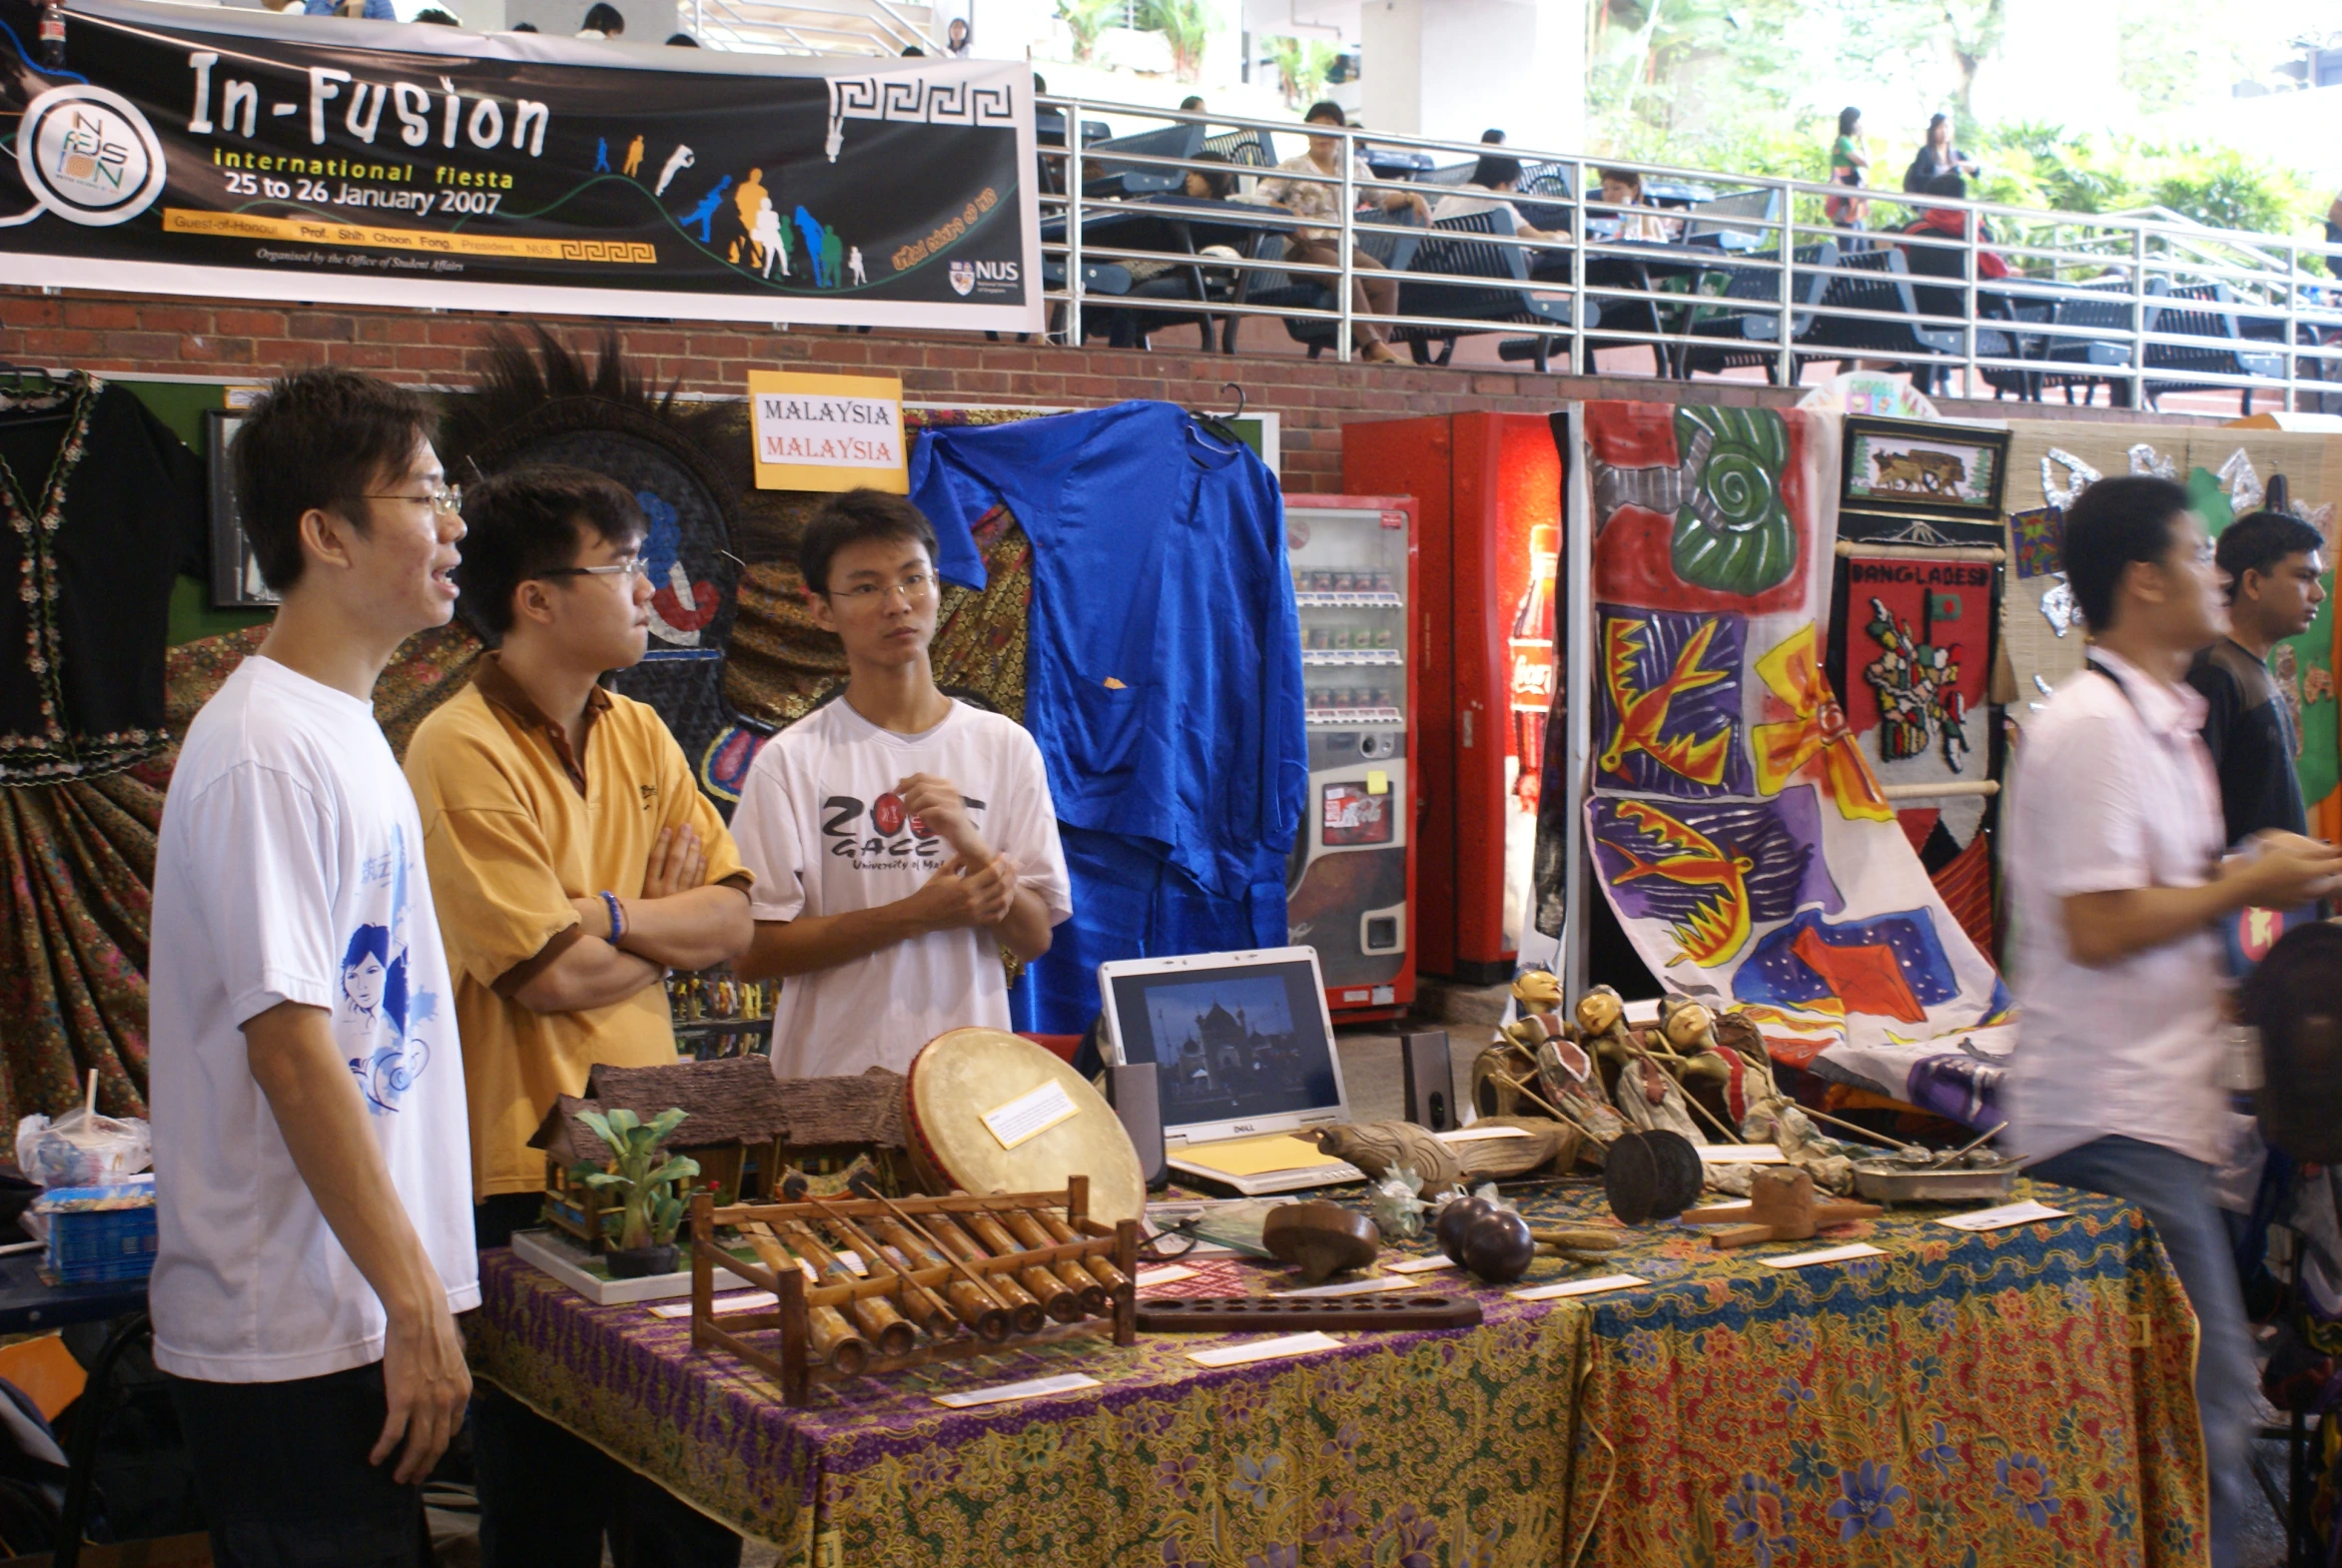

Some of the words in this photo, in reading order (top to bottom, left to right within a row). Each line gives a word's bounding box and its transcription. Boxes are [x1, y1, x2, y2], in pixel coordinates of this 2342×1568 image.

[188, 52, 549, 157] In-Fusion
[213, 147, 413, 183] international
[435, 166, 514, 190] fiesta
[223, 171, 258, 196] 25
[262, 177, 291, 200] to
[296, 179, 330, 203] 26
[332, 182, 435, 217] January
[438, 190, 502, 215] 2007
[301, 226, 330, 240] Prof.
[339, 229, 366, 242] Shih
[373, 232, 412, 245] Choon
[526, 244, 552, 255] NUS
[256, 248, 312, 263] Organised
[313, 252, 325, 265] by
[327, 253, 345, 264] the
[346, 254, 378, 268] Office
[379, 257, 391, 269] of
[391, 257, 430, 270] Student
[430, 260, 464, 273] Affairs
[975, 261, 1020, 281] NUS
[764, 399, 891, 425] MALAYSIA
[766, 436, 892, 461] MALAYSIA
[853, 858, 908, 871] University
[912, 860, 920, 871] of
